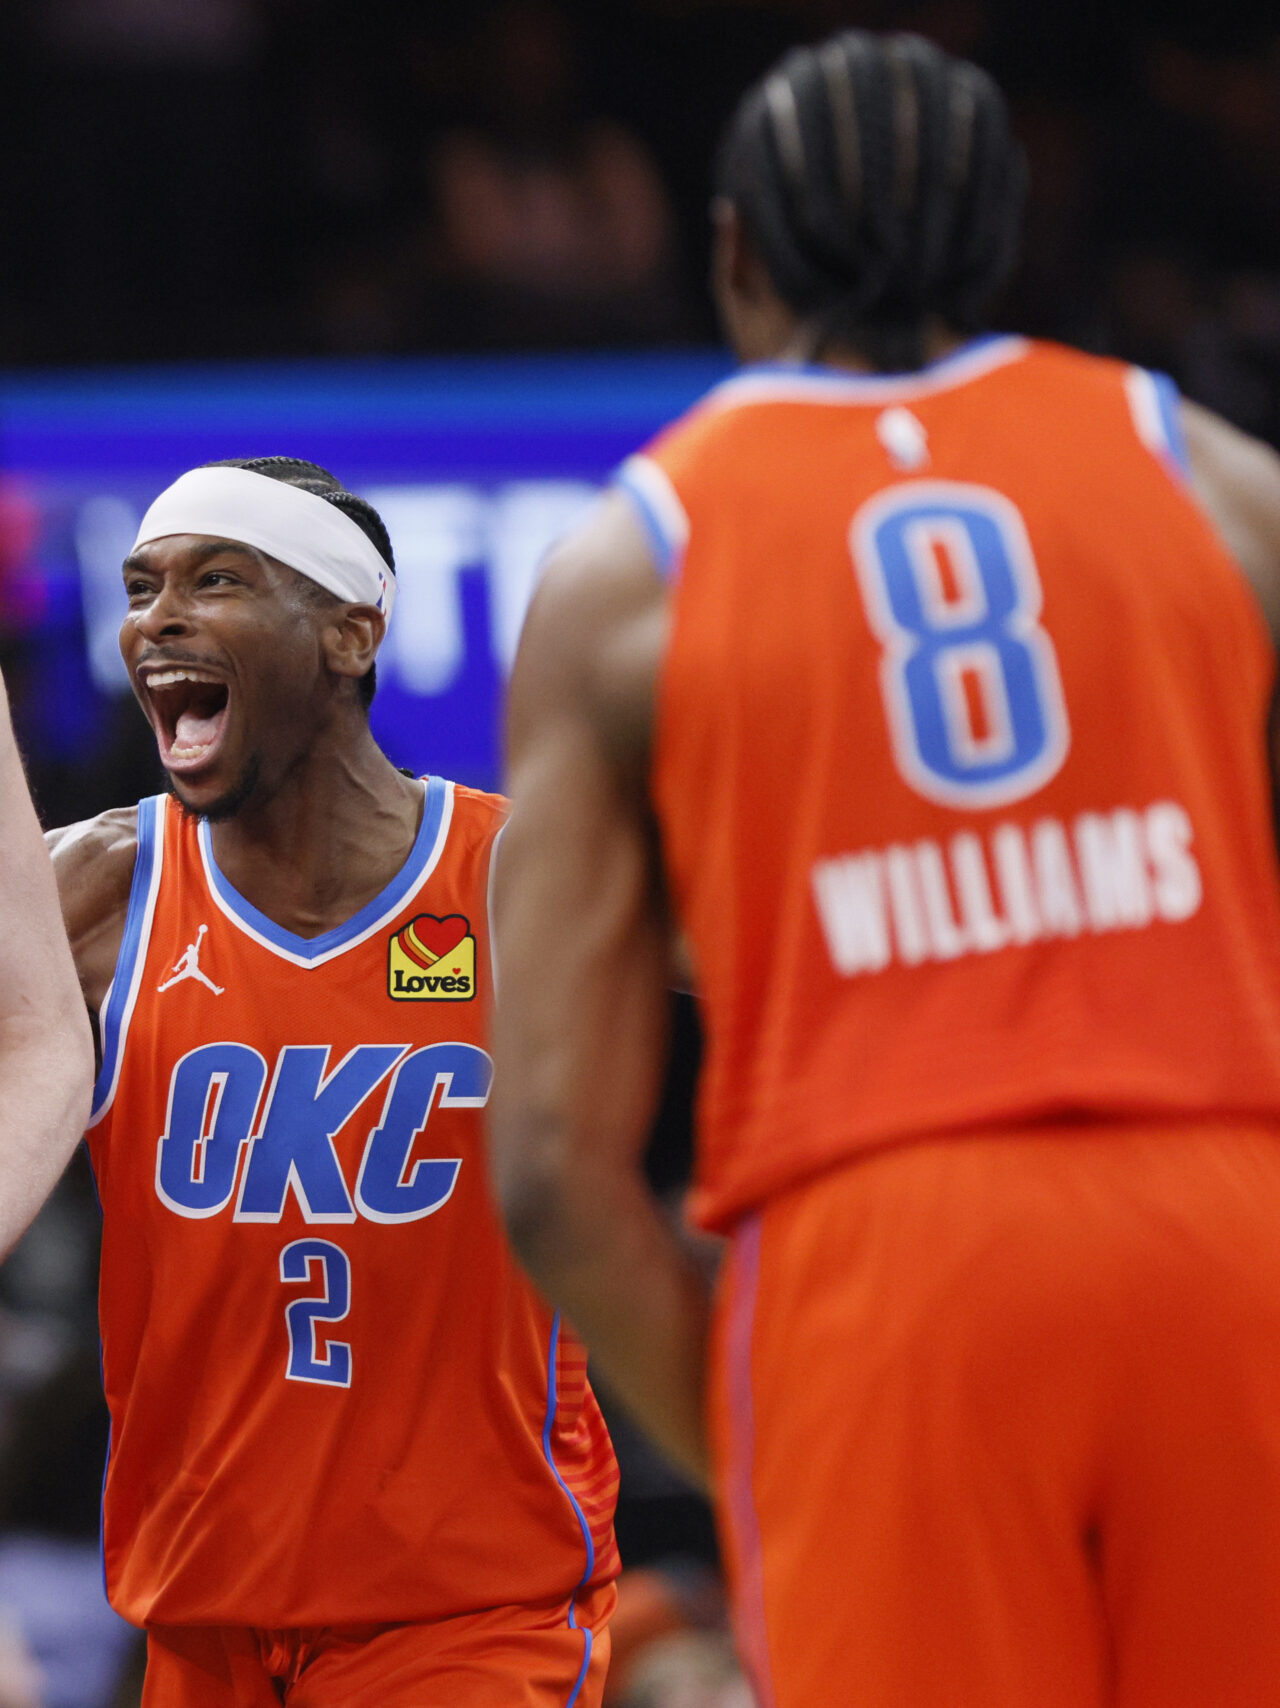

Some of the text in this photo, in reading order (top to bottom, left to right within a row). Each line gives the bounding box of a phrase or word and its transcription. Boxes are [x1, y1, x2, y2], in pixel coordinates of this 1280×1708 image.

[849, 479, 1070, 811] 8
[812, 801, 1201, 978] WILLIAMS
[155, 1042, 494, 1224] OKC
[279, 1238, 351, 1388] 2
